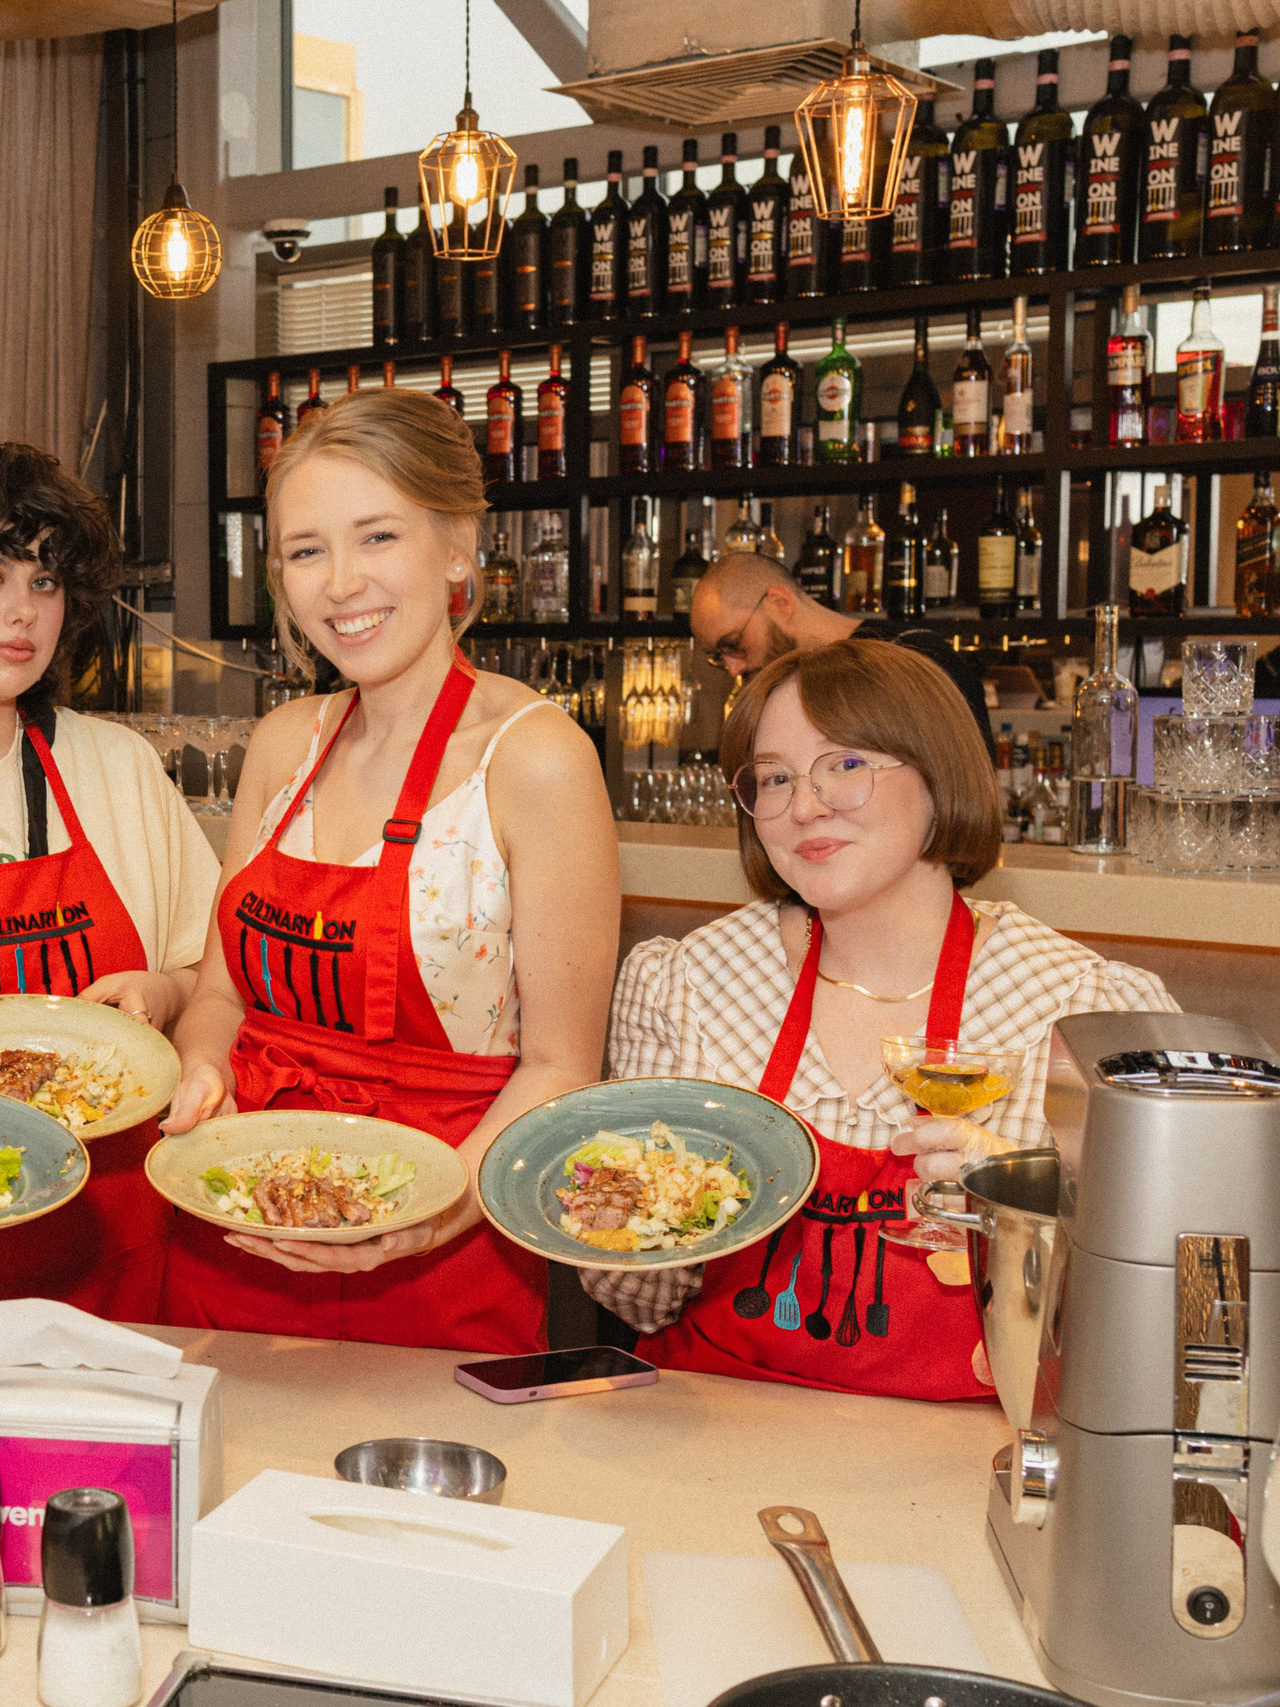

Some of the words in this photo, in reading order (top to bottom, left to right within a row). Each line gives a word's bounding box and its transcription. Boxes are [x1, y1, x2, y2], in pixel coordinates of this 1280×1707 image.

[1151, 117, 1179, 143] W
[1214, 111, 1242, 137] W
[1092, 132, 1121, 157] W
[1149, 142, 1179, 160] INE
[1212, 136, 1241, 154] INE
[953, 150, 977, 174] W
[1018, 142, 1044, 168] W
[1089, 156, 1120, 173] INE
[1211, 162, 1237, 179] ON
[1017, 166, 1044, 184] INE
[1148, 168, 1175, 185] ON
[1088, 181, 1116, 198] ON
[950, 198, 973, 213] ON
[1016, 191, 1040, 209] ON
[709, 207, 729, 227] W
[752, 200, 775, 219] W
[628, 219, 646, 237] W
[669, 212, 688, 232] W
[789, 217, 811, 233] ON
[594, 222, 614, 241] W
[751, 239, 772, 251] ON
